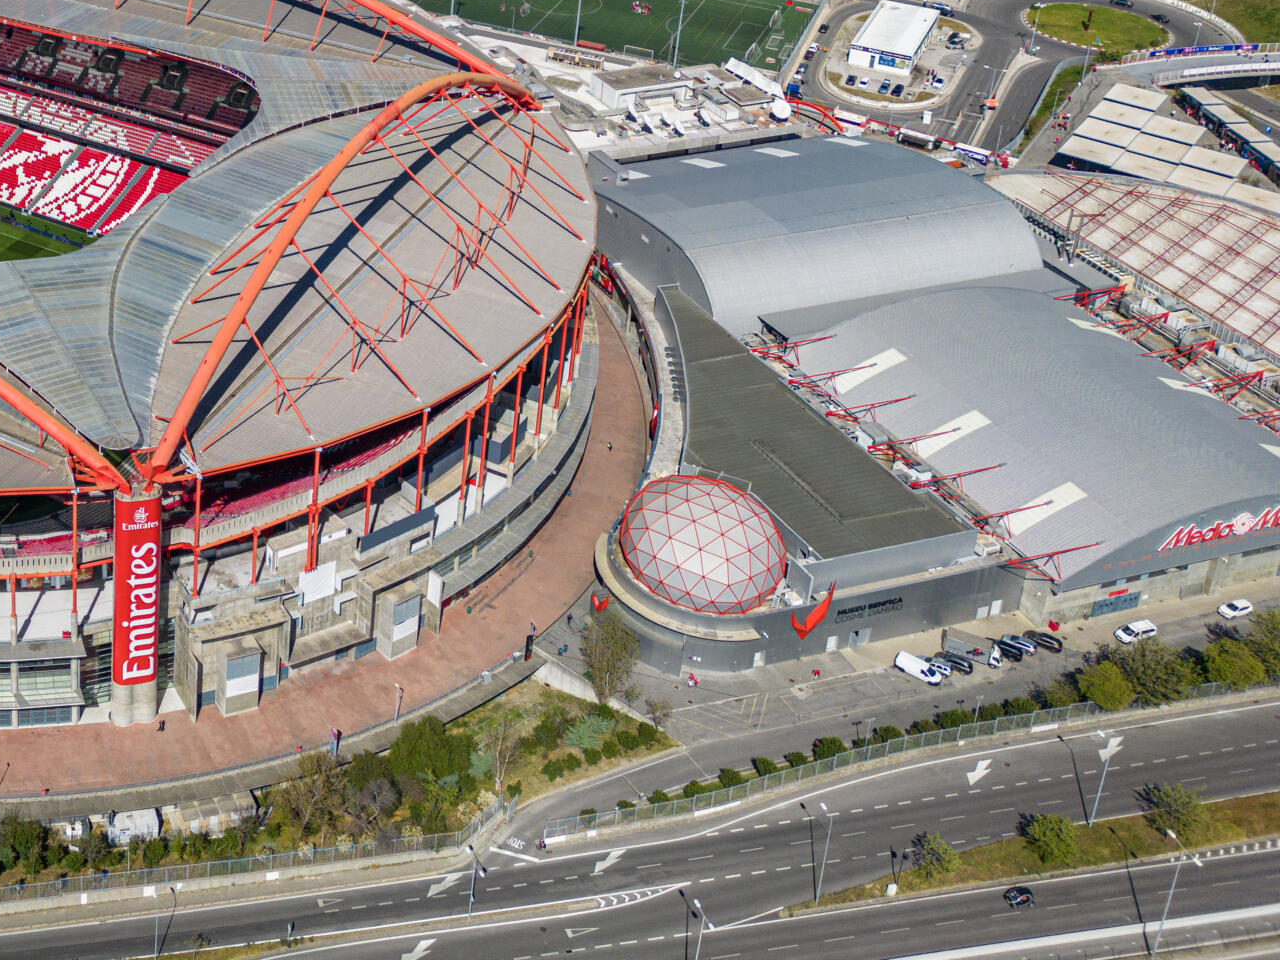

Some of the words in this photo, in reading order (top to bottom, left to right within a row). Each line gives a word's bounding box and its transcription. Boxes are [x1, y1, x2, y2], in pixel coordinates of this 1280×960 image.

[122, 520, 159, 531] Emirates
[1158, 520, 1234, 551] Media
[122, 542, 158, 680] Emirates
[837, 605, 866, 617] MUSEU
[867, 597, 903, 610] BENFICA
[506, 837, 525, 849] STOP
